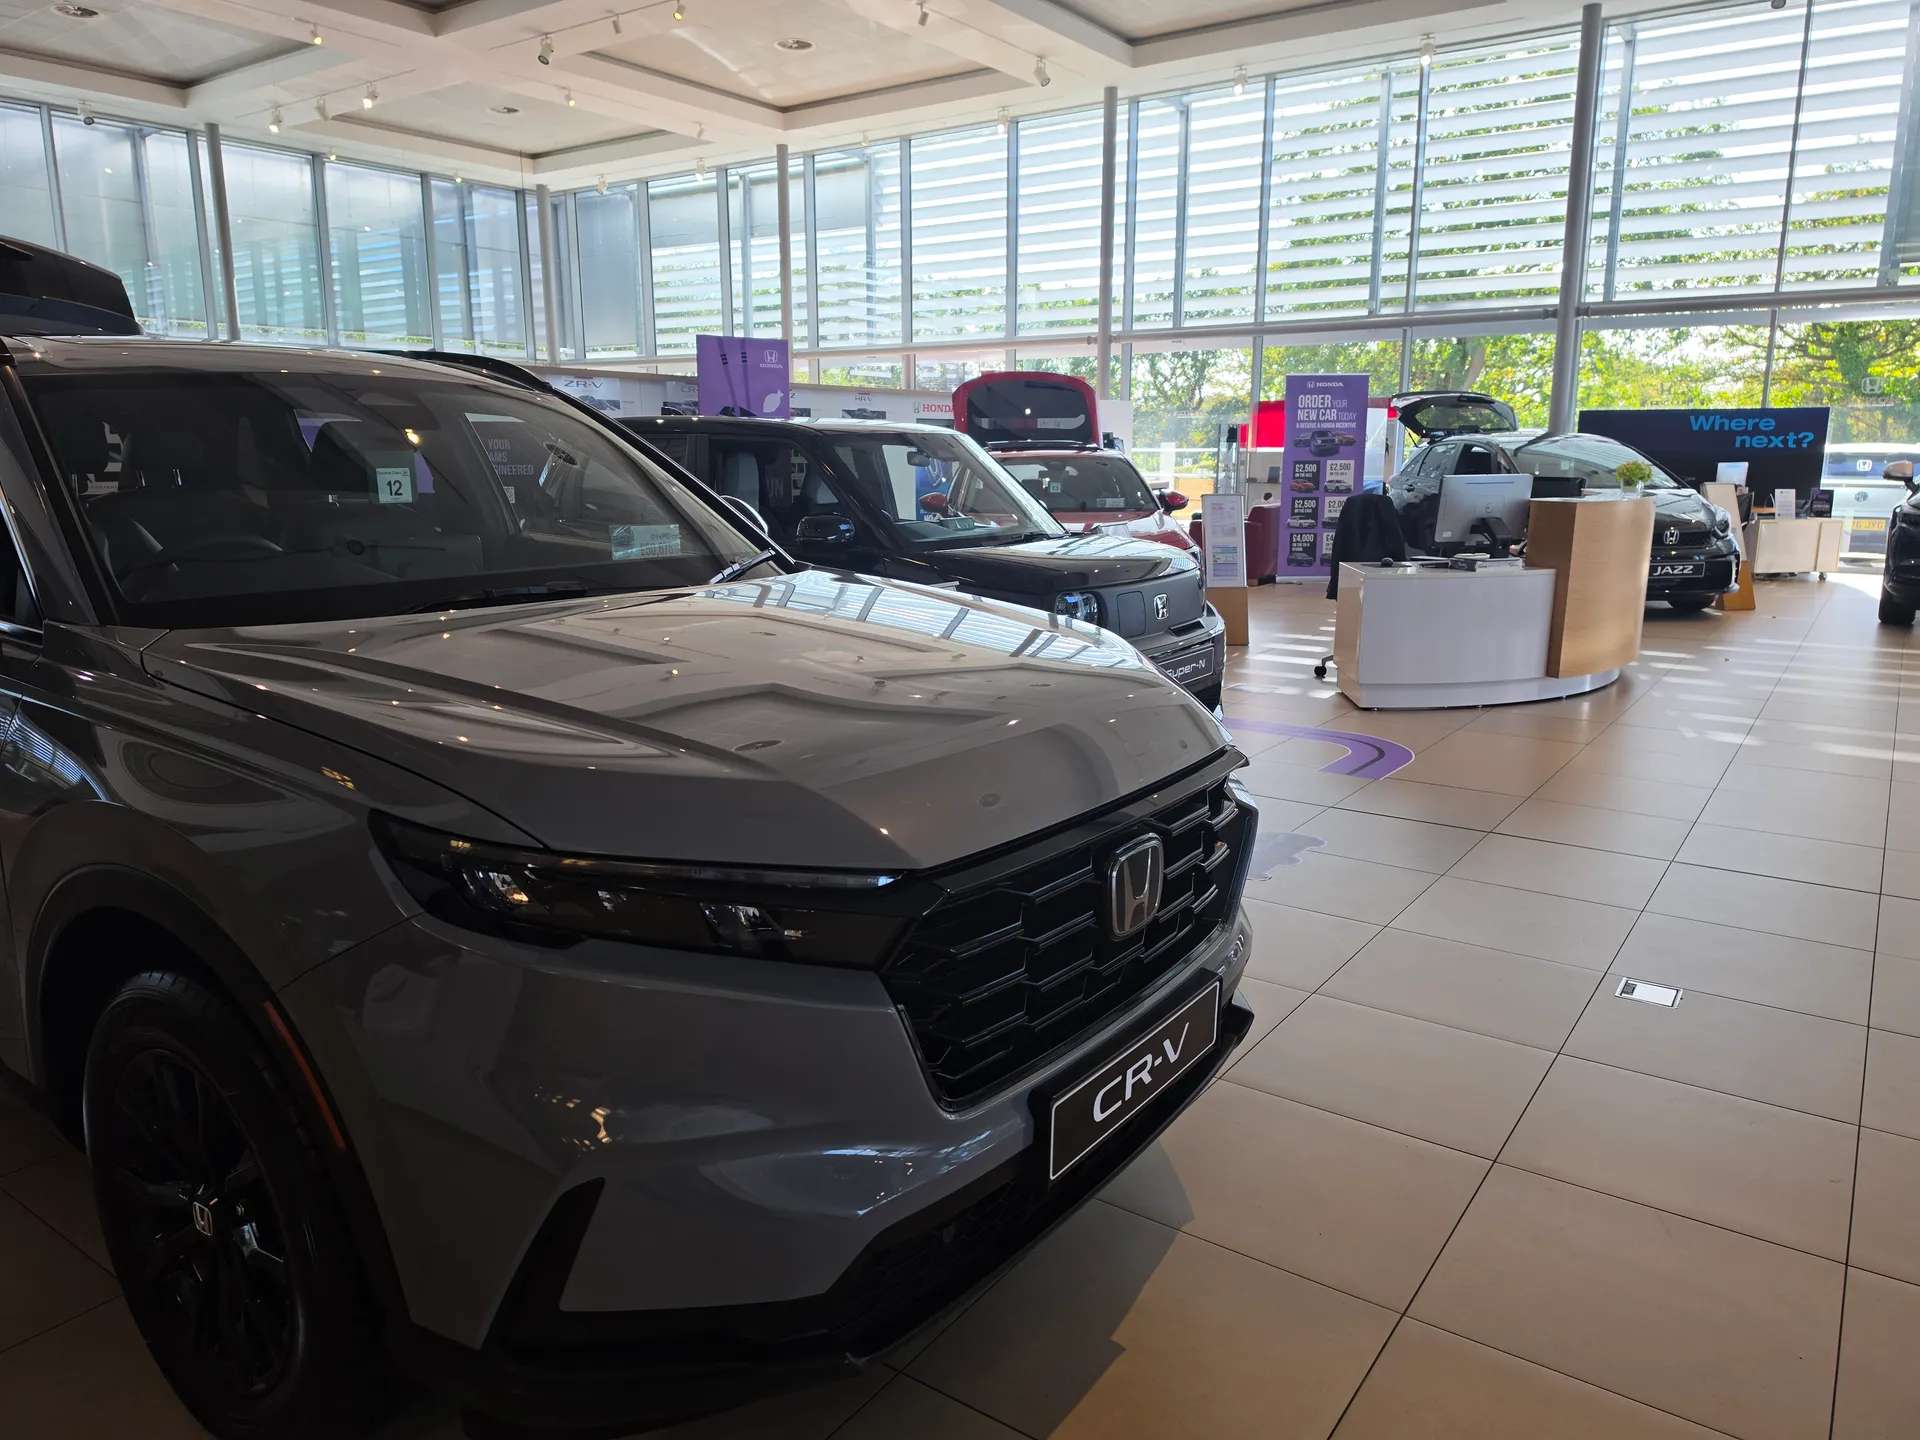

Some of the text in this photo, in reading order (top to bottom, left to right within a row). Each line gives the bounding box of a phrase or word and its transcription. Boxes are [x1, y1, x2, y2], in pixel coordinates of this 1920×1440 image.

[564, 379, 603, 389] ZR-V
[1298, 394, 1348, 408] ORDER YOUR
[1297, 408, 1317, 421] NEW
[1319, 408, 1337, 421] CAR
[1690, 415, 1776, 431] Where
[1735, 431, 1815, 448] next?
[386, 479, 404, 497] 12
[1653, 565, 1694, 576] JAZZ
[1092, 1021, 1190, 1123] CR-V
